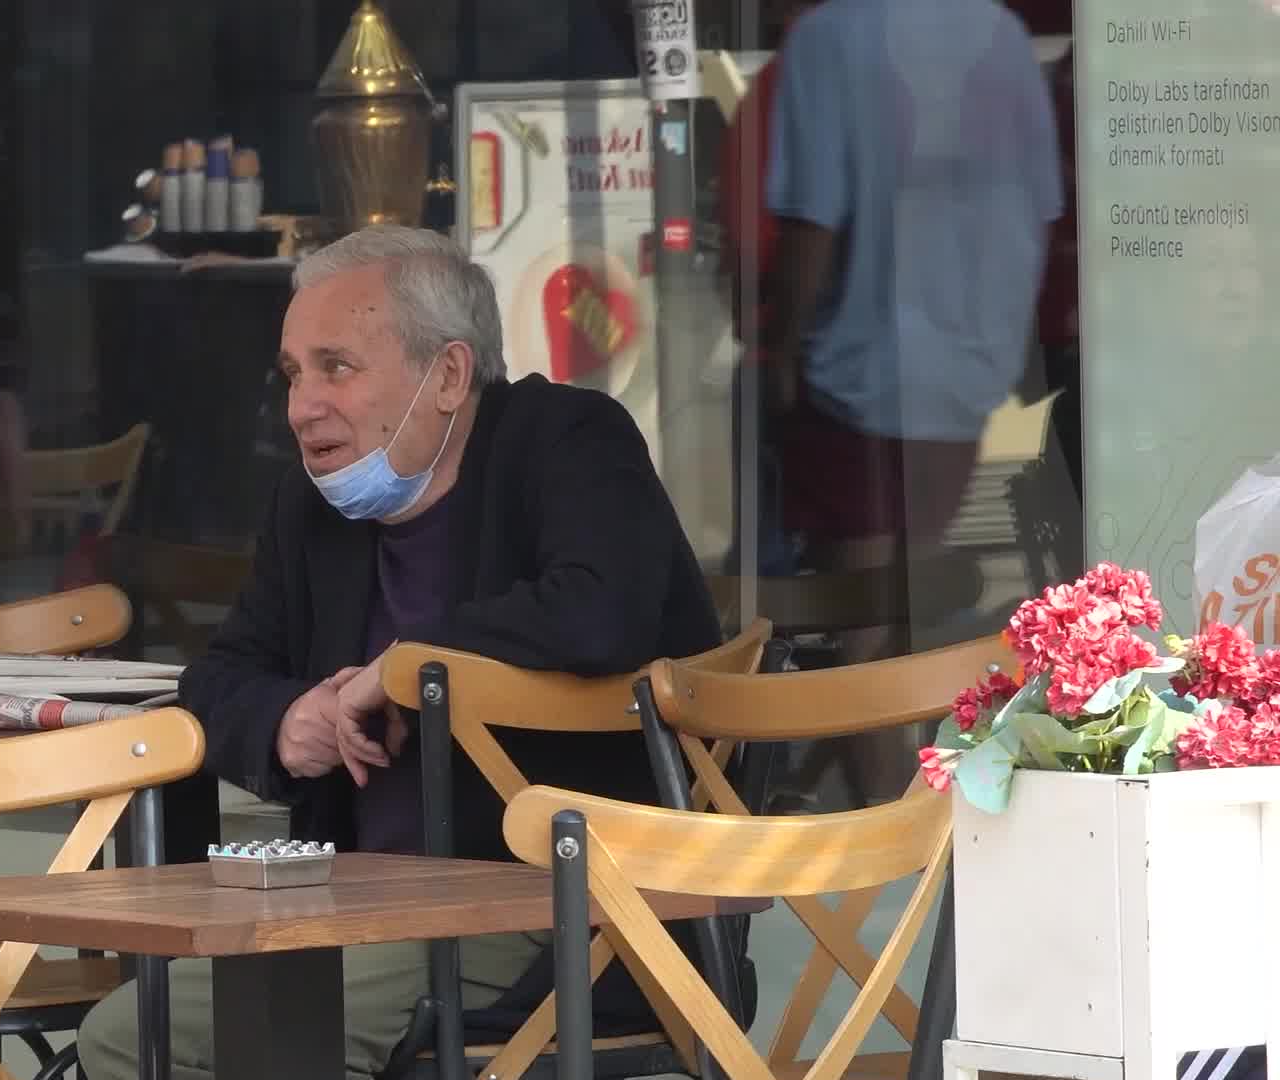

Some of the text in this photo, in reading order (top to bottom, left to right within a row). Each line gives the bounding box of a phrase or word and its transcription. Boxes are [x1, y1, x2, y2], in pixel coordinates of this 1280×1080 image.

[1106, 20, 1191, 43] Dahili Wi-Fi
[1107, 80, 1150, 104] Dolby
[1154, 79, 1189, 101] Labs
[1108, 111, 1280, 138] geliştirilen Dolby Vision
[1109, 144, 1225, 167] dinamik formatı
[1109, 201, 1249, 229] Görüntü teknolojisi
[1111, 235, 1184, 259] Pixellence
